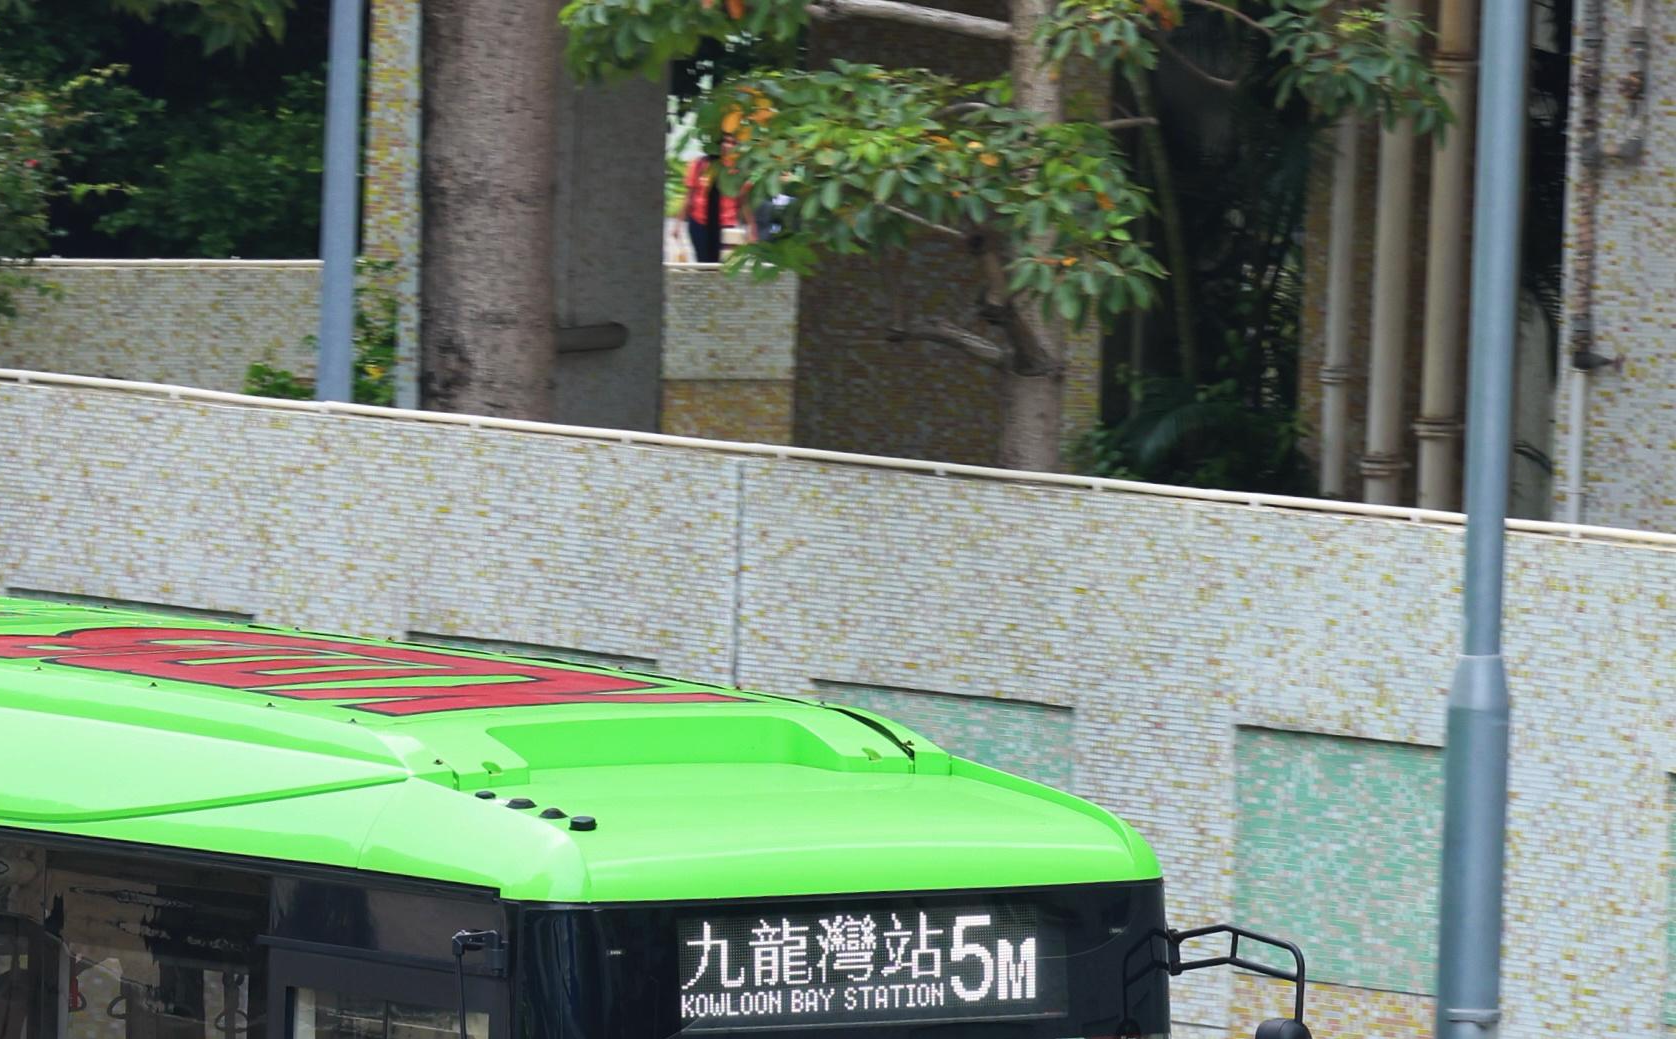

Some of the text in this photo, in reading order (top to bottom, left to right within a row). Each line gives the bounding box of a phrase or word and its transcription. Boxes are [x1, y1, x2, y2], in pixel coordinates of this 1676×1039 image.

[681, 911, 943, 989] 九龍灣站
[950, 914, 1037, 1002] 5M
[681, 982, 945, 1018] KOWLOON BAY STATION
